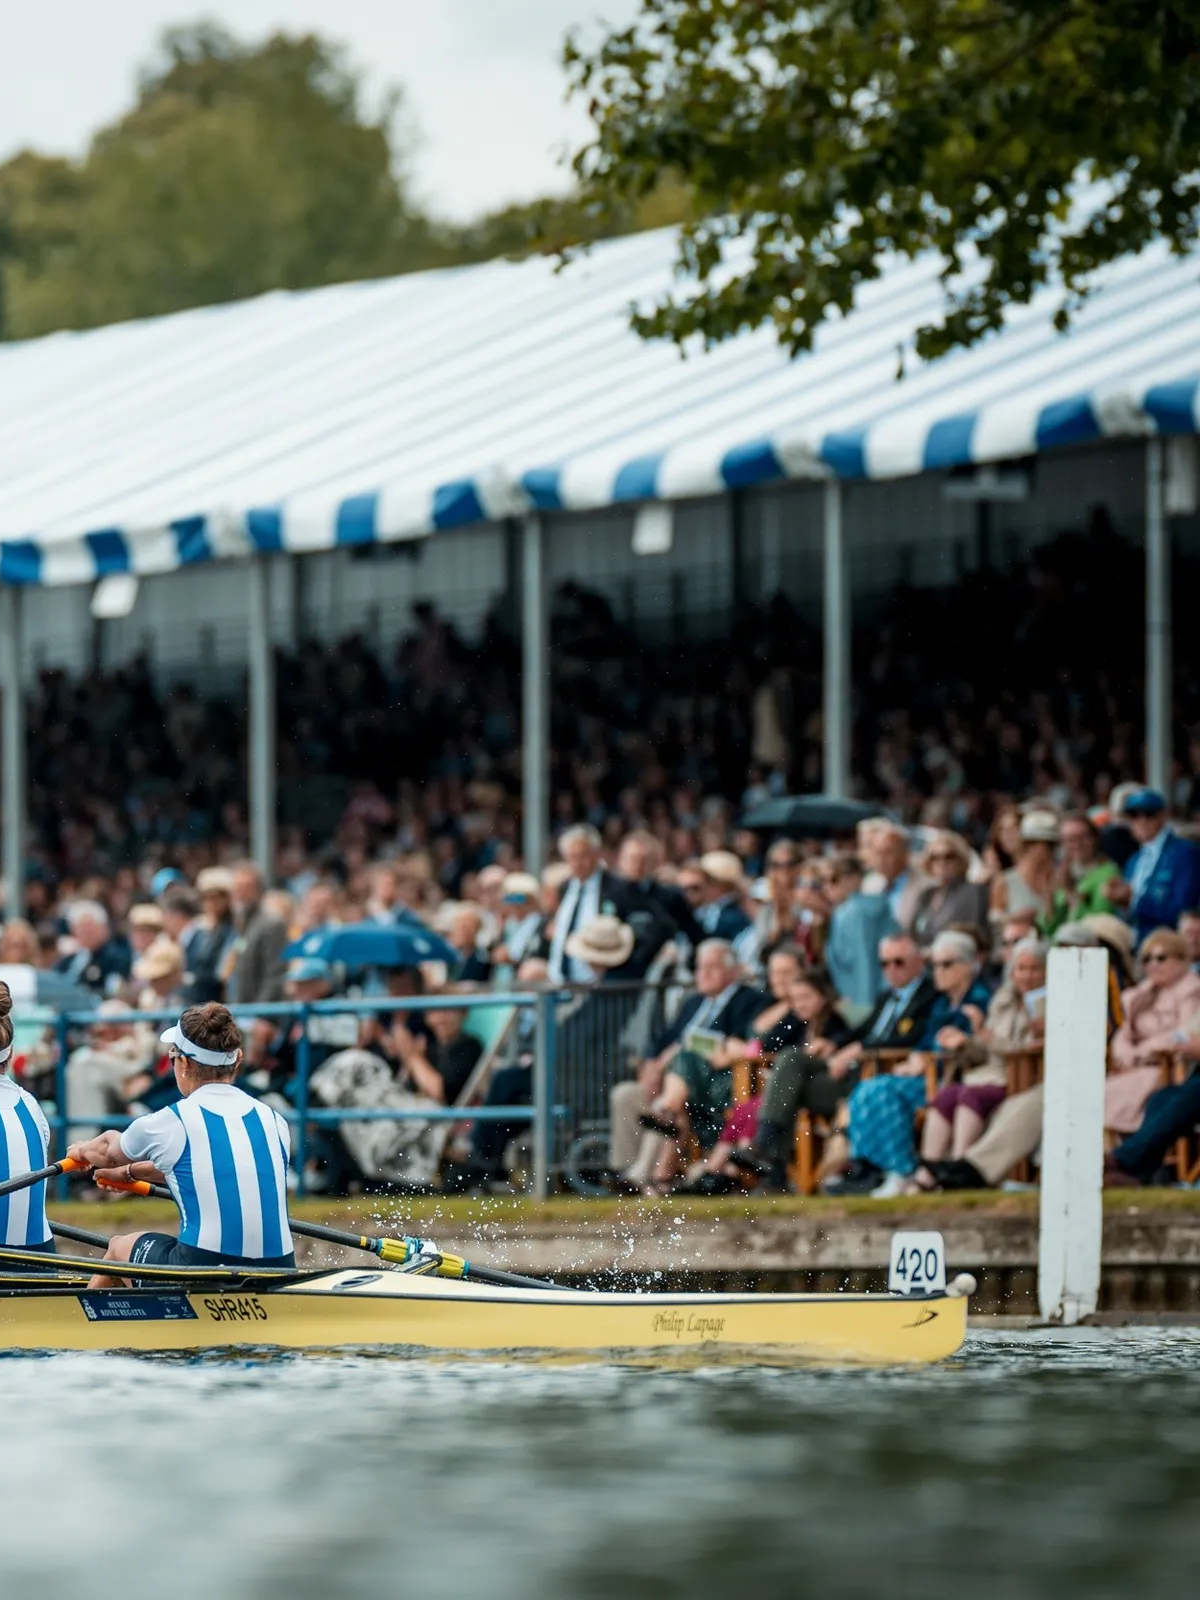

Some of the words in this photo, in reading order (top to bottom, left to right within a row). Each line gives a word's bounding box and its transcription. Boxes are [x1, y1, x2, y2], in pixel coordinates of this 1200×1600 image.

[895, 1247, 938, 1281] 420
[100, 1309, 120, 1317] ROYAL
[107, 1301, 131, 1309] HENLEY
[203, 1298, 268, 1321] SHR415
[653, 1310, 685, 1339] Philip
